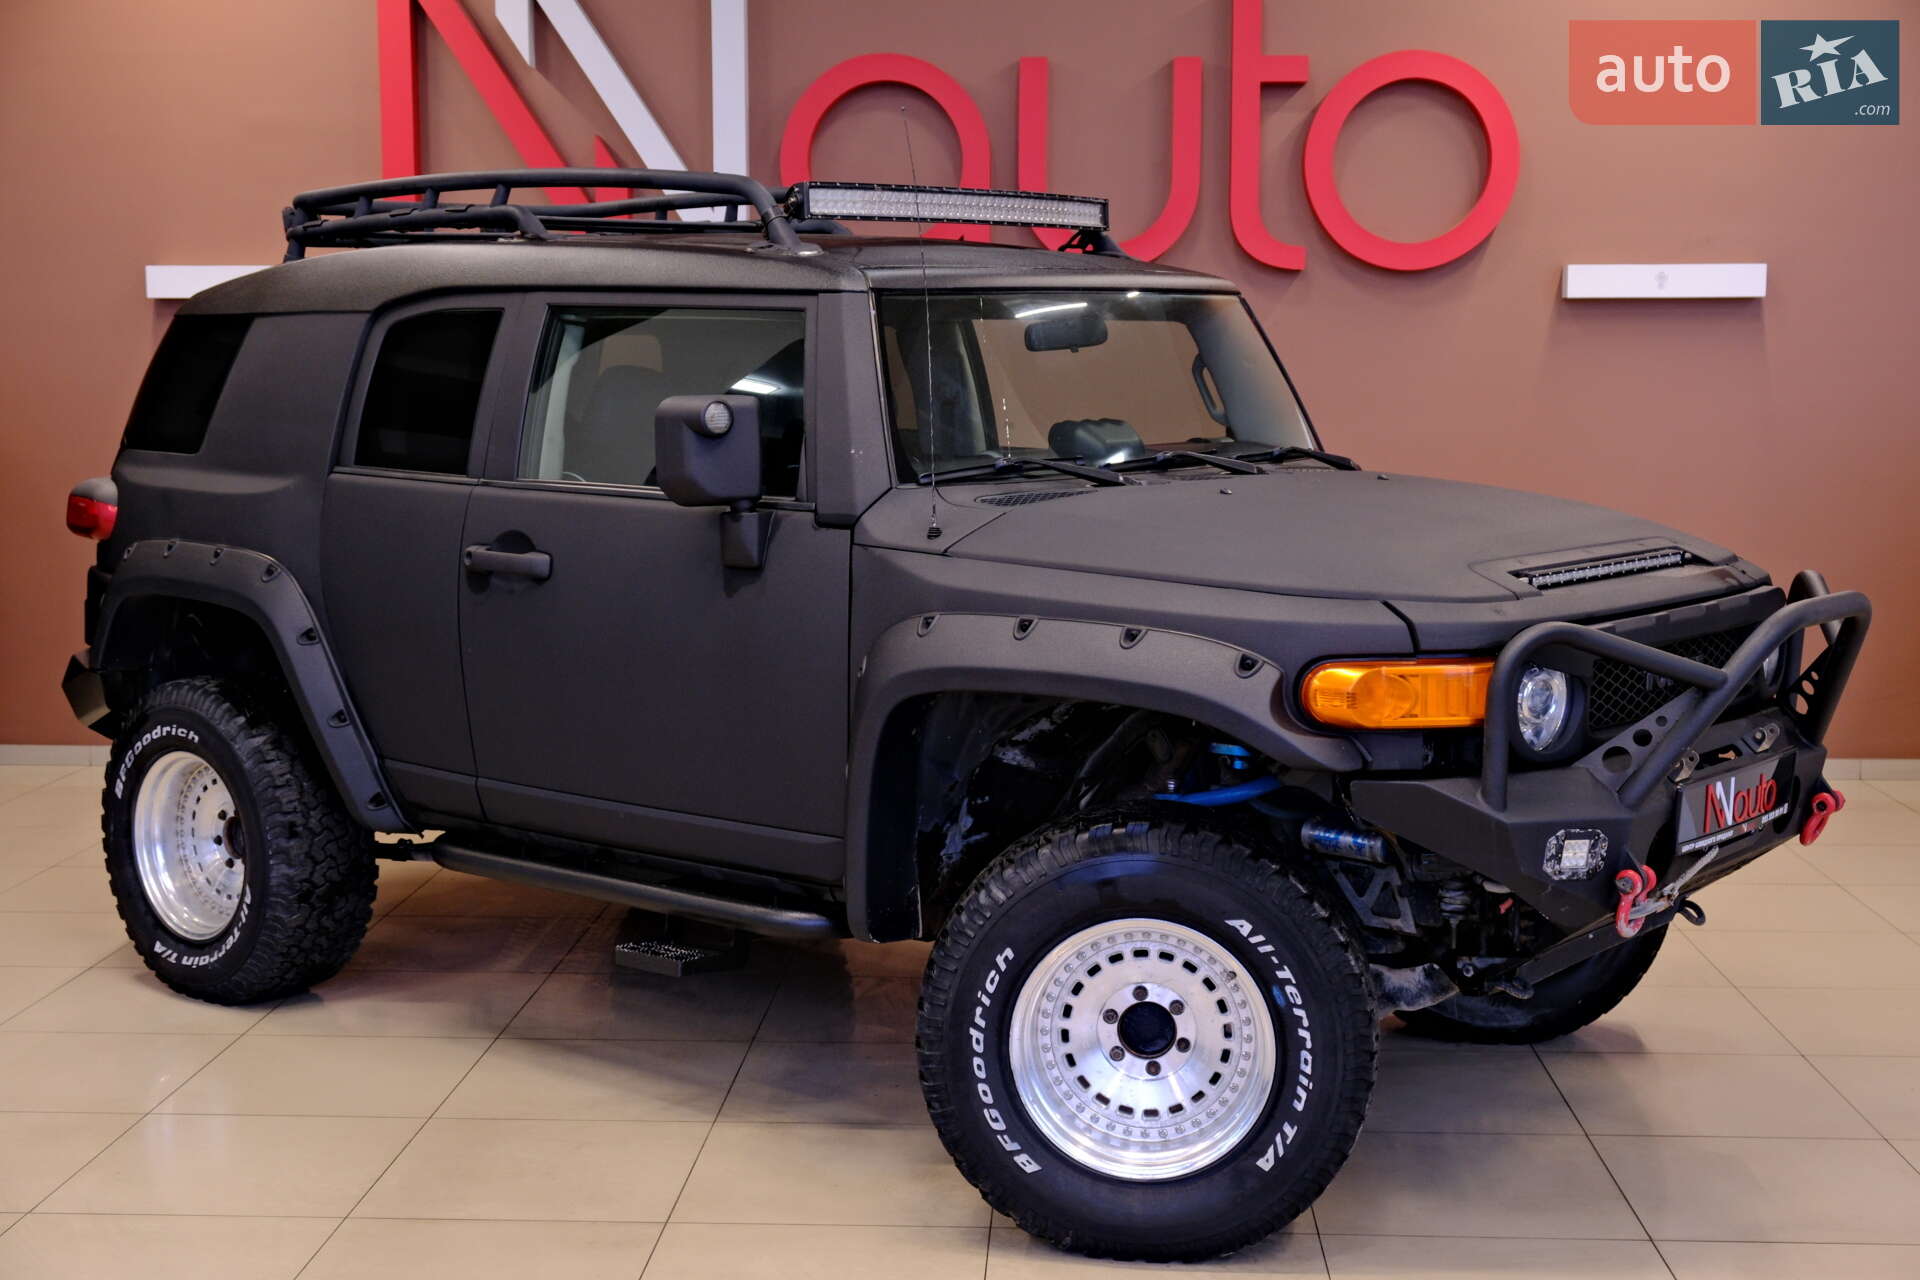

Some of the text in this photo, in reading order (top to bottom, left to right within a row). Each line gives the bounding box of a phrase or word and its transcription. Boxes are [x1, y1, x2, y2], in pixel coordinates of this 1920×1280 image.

[114, 724, 200, 799] BFGoodrich
[153, 940, 177, 964] T/A
[968, 946, 1042, 1174] BFGoodrich
[1225, 919, 1313, 1173] All-Terrain T/A
